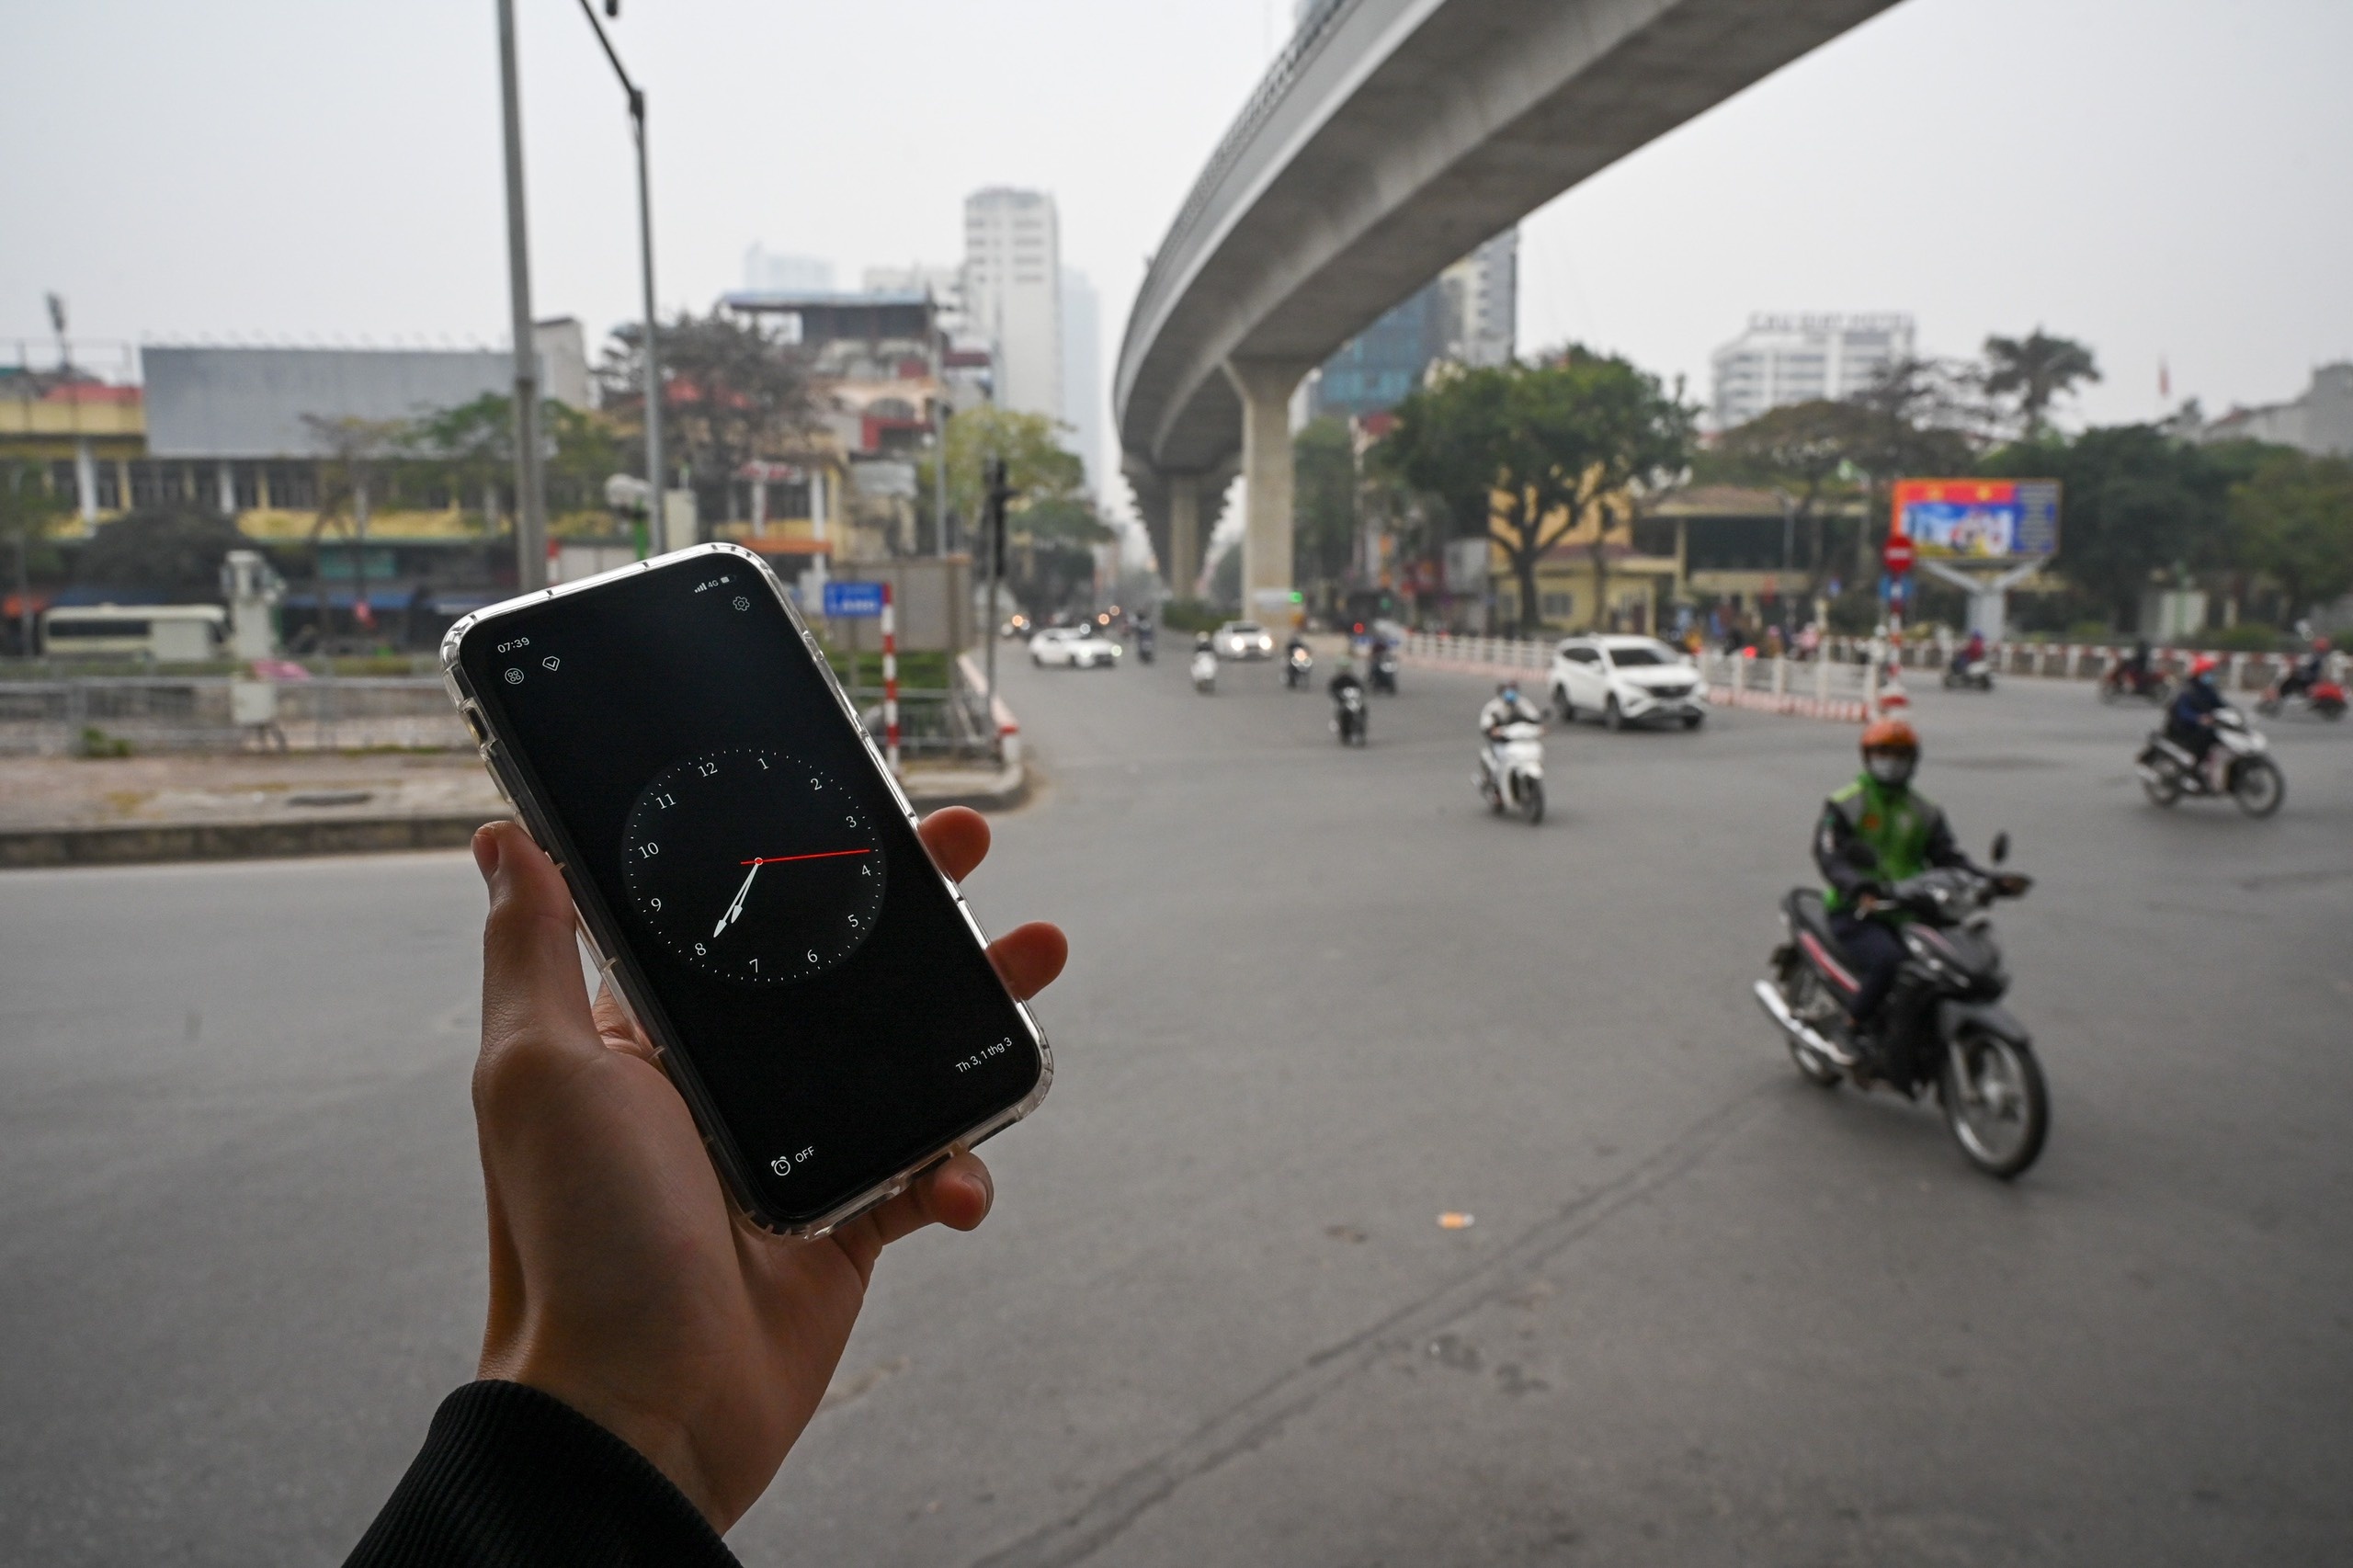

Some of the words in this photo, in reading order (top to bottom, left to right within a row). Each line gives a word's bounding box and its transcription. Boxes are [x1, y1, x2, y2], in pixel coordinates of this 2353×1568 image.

[497, 637, 530, 653] 07:39
[699, 762, 718, 778] 12
[758, 757, 769, 770] 1
[811, 778, 823, 791] 2
[655, 793, 676, 810] 11
[846, 815, 857, 828] 3
[639, 842, 659, 859] 10
[861, 864, 871, 877] 4
[651, 897, 662, 912] 9
[847, 914, 859, 927] 5
[695, 942, 707, 956] 8
[807, 949, 818, 963] 6
[748, 958, 758, 973] 7
[955, 1061, 972, 1073] Th
[970, 1055, 982, 1065] 3,
[980, 1051, 988, 1060] 1
[987, 1042, 1006, 1056] thg
[1004, 1037, 1013, 1047] 3
[795, 1145, 814, 1163] OFF
